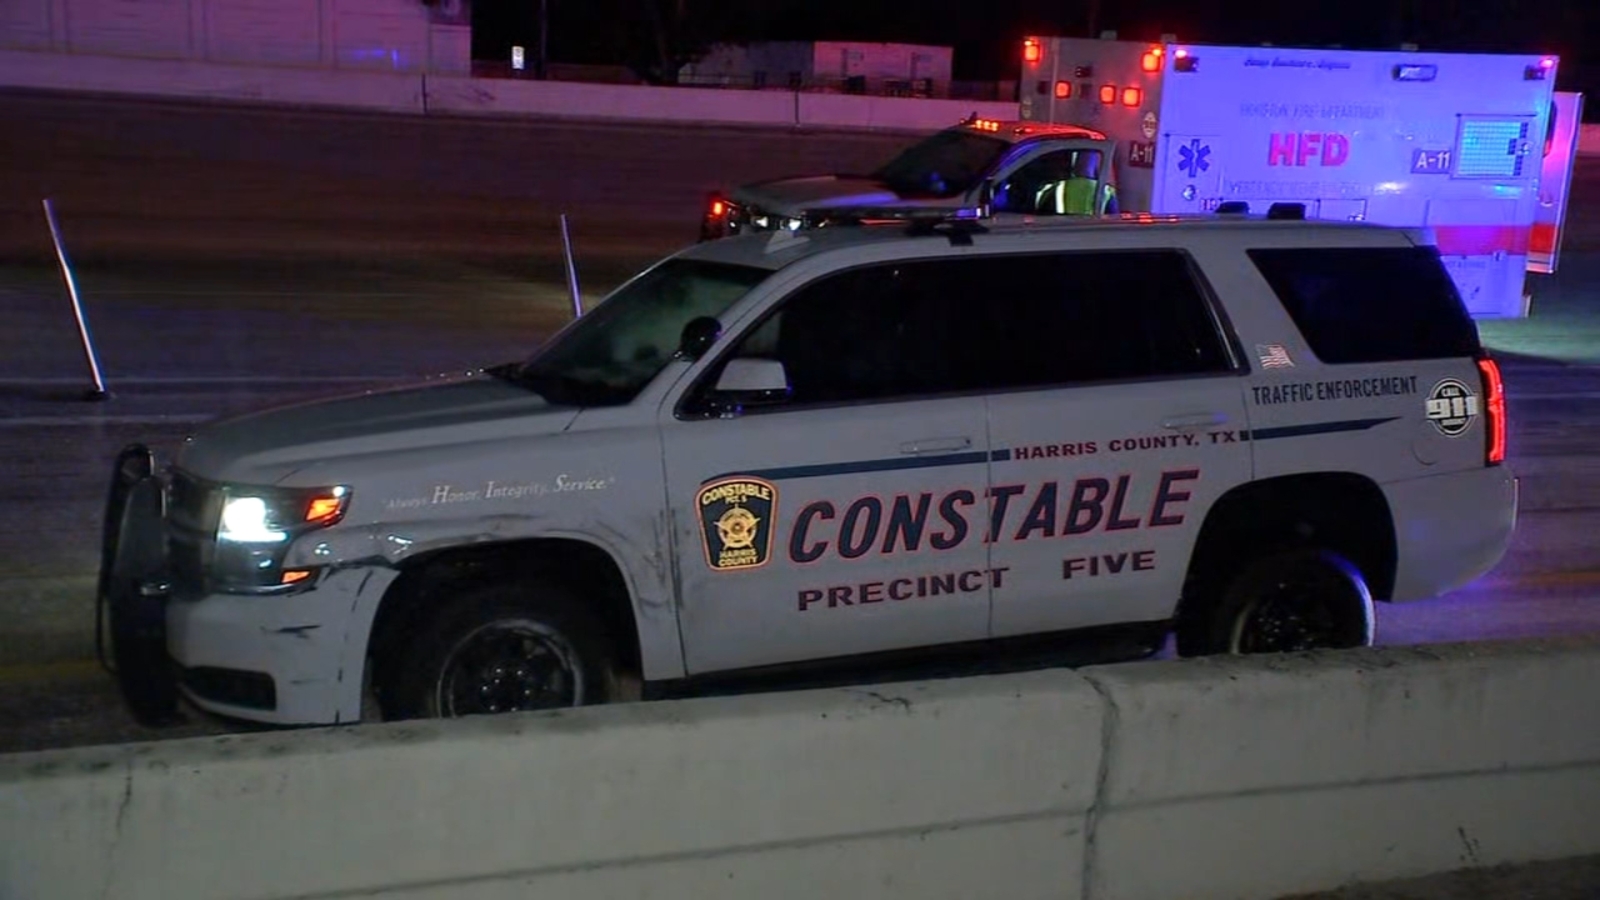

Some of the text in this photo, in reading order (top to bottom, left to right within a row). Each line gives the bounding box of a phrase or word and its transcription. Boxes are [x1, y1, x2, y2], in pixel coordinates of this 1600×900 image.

[1130, 143, 1154, 164] A-11
[1267, 133, 1350, 167] HFD
[1416, 151, 1450, 169] A-11
[1252, 375, 1418, 405] TRAFFIC ENFORCEMENT
[1426, 395, 1478, 419] 911
[1014, 441, 1098, 460] HARRIS
[1208, 430, 1236, 444] TX
[702, 483, 771, 505] CONSTABLE
[790, 469, 1200, 563] CONSTABLE
[798, 550, 1156, 611] PRECINCT FIVE
